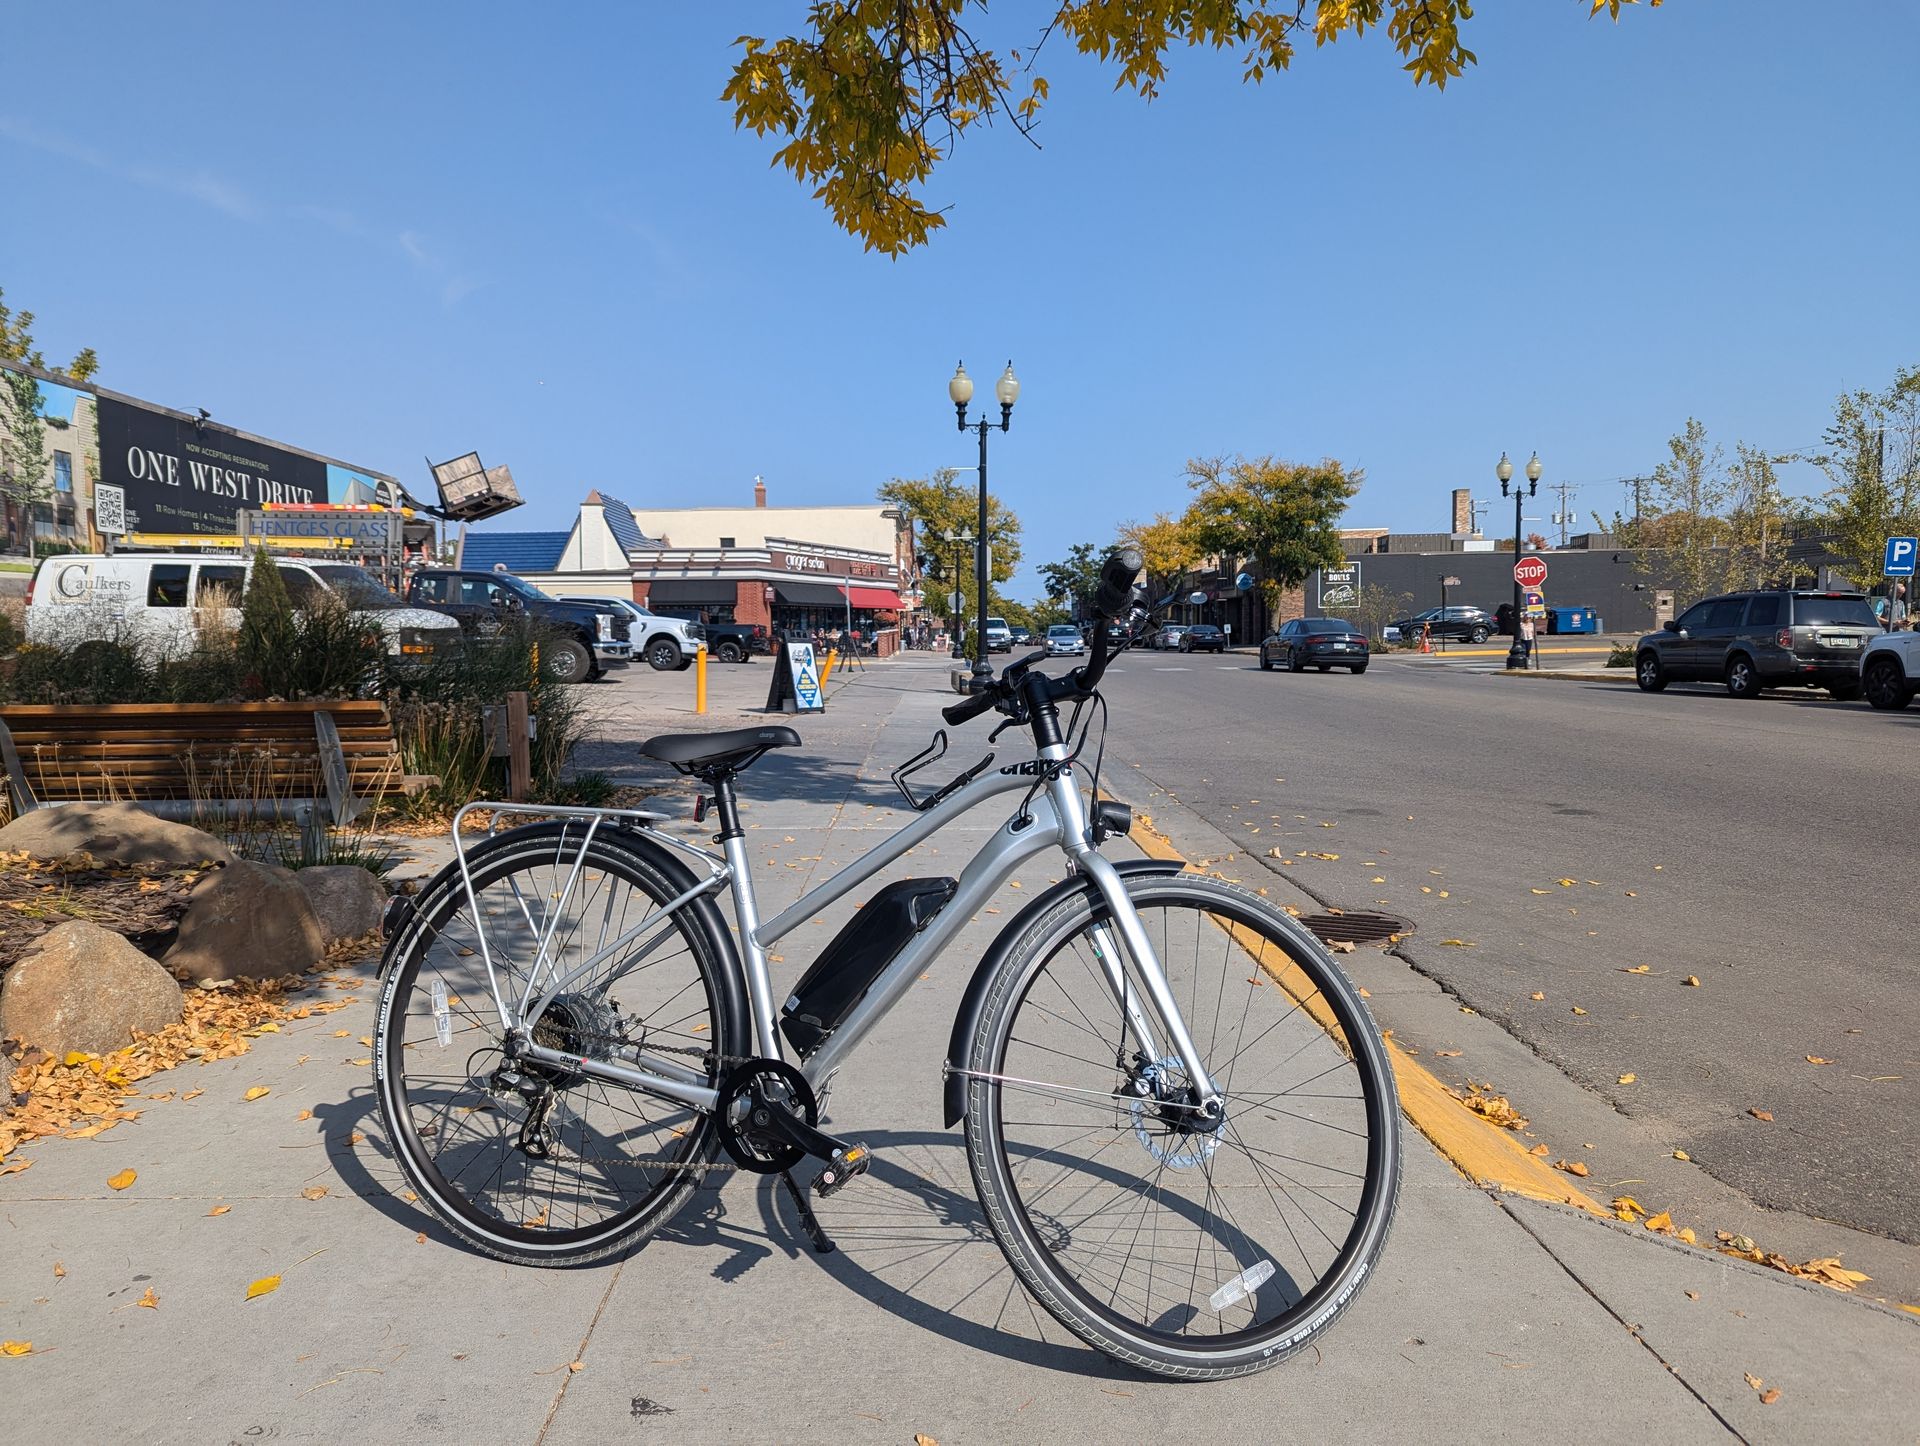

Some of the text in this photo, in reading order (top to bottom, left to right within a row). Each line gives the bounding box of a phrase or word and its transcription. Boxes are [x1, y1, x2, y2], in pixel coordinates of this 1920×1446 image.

[185, 443, 270, 472] NOW ACCEPTING RESERVATIONS
[127, 446, 313, 505] ONE WEST DRIVE
[125, 508, 137, 517] ONE
[163, 505, 177, 515] Row
[178, 507, 199, 519] Homes
[192, 521, 200, 531] 15
[251, 519, 389, 538] HENTGES GLASS
[1893, 541, 1911, 561] P
[57, 564, 131, 597] Caulkers
[1517, 565, 1545, 579] STOP
[378, 1003, 387, 1033] TRANSIT
[383, 983, 392, 1002] TOUR
[1339, 1263, 1368, 1304] GOODYEAR
[1312, 1304, 1338, 1330] TRANSIT
[1293, 1327, 1312, 1342] TOUR
